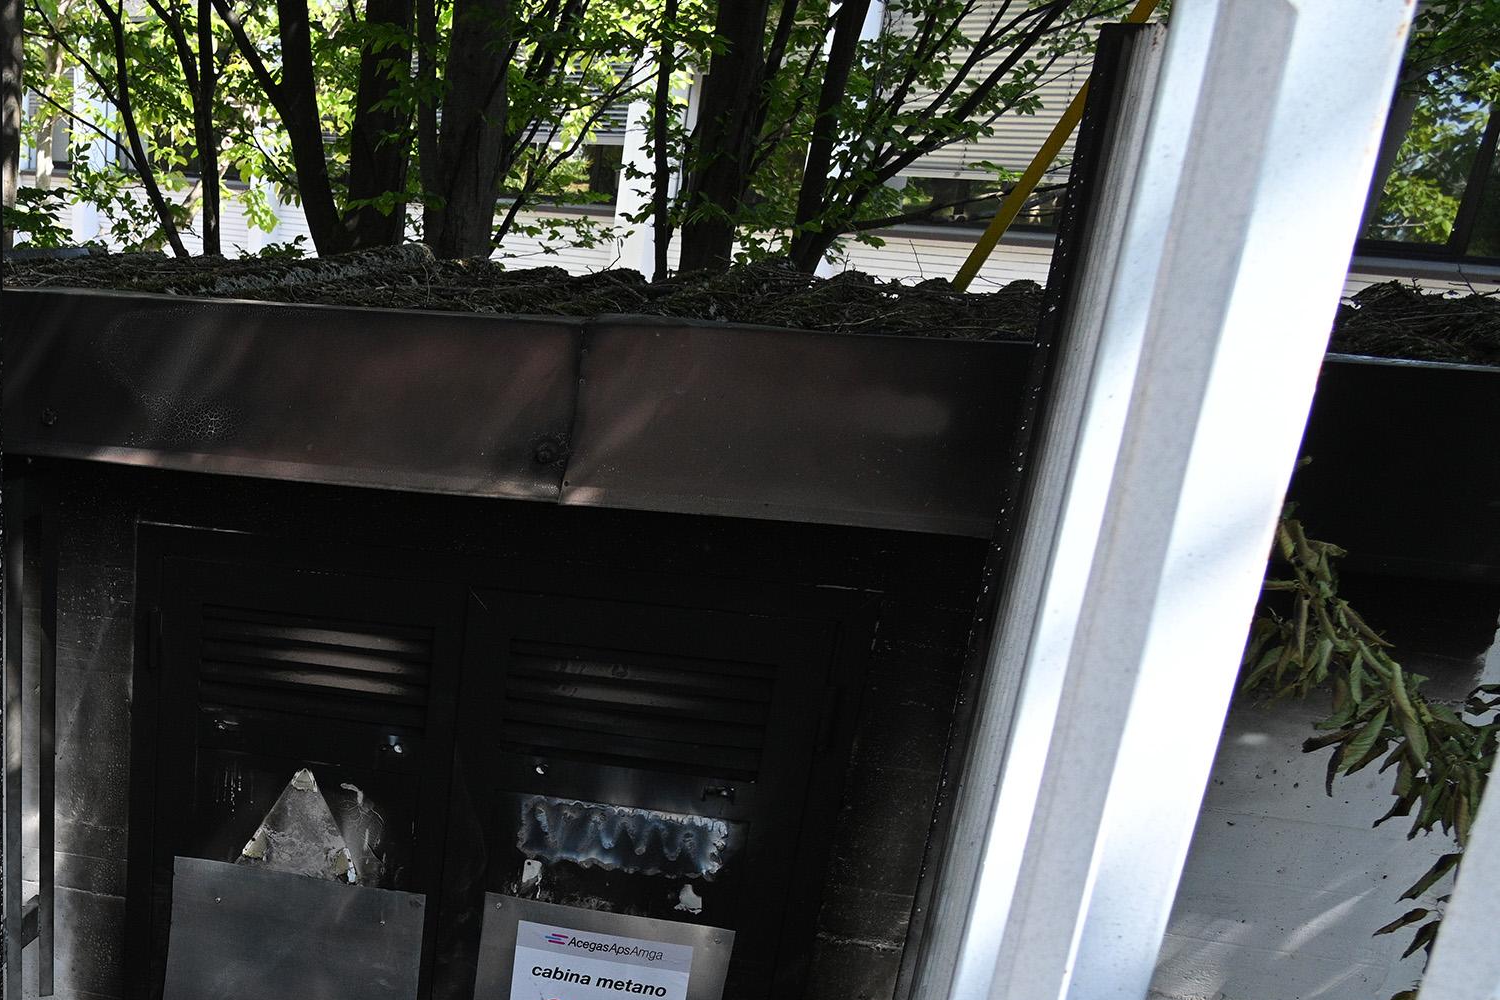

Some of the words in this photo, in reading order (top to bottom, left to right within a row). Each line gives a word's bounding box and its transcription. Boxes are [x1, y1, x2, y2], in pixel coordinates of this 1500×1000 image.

[568, 937, 663, 961] AcegasApsAmga
[531, 965, 591, 985] cabina
[596, 976, 667, 997] metano
